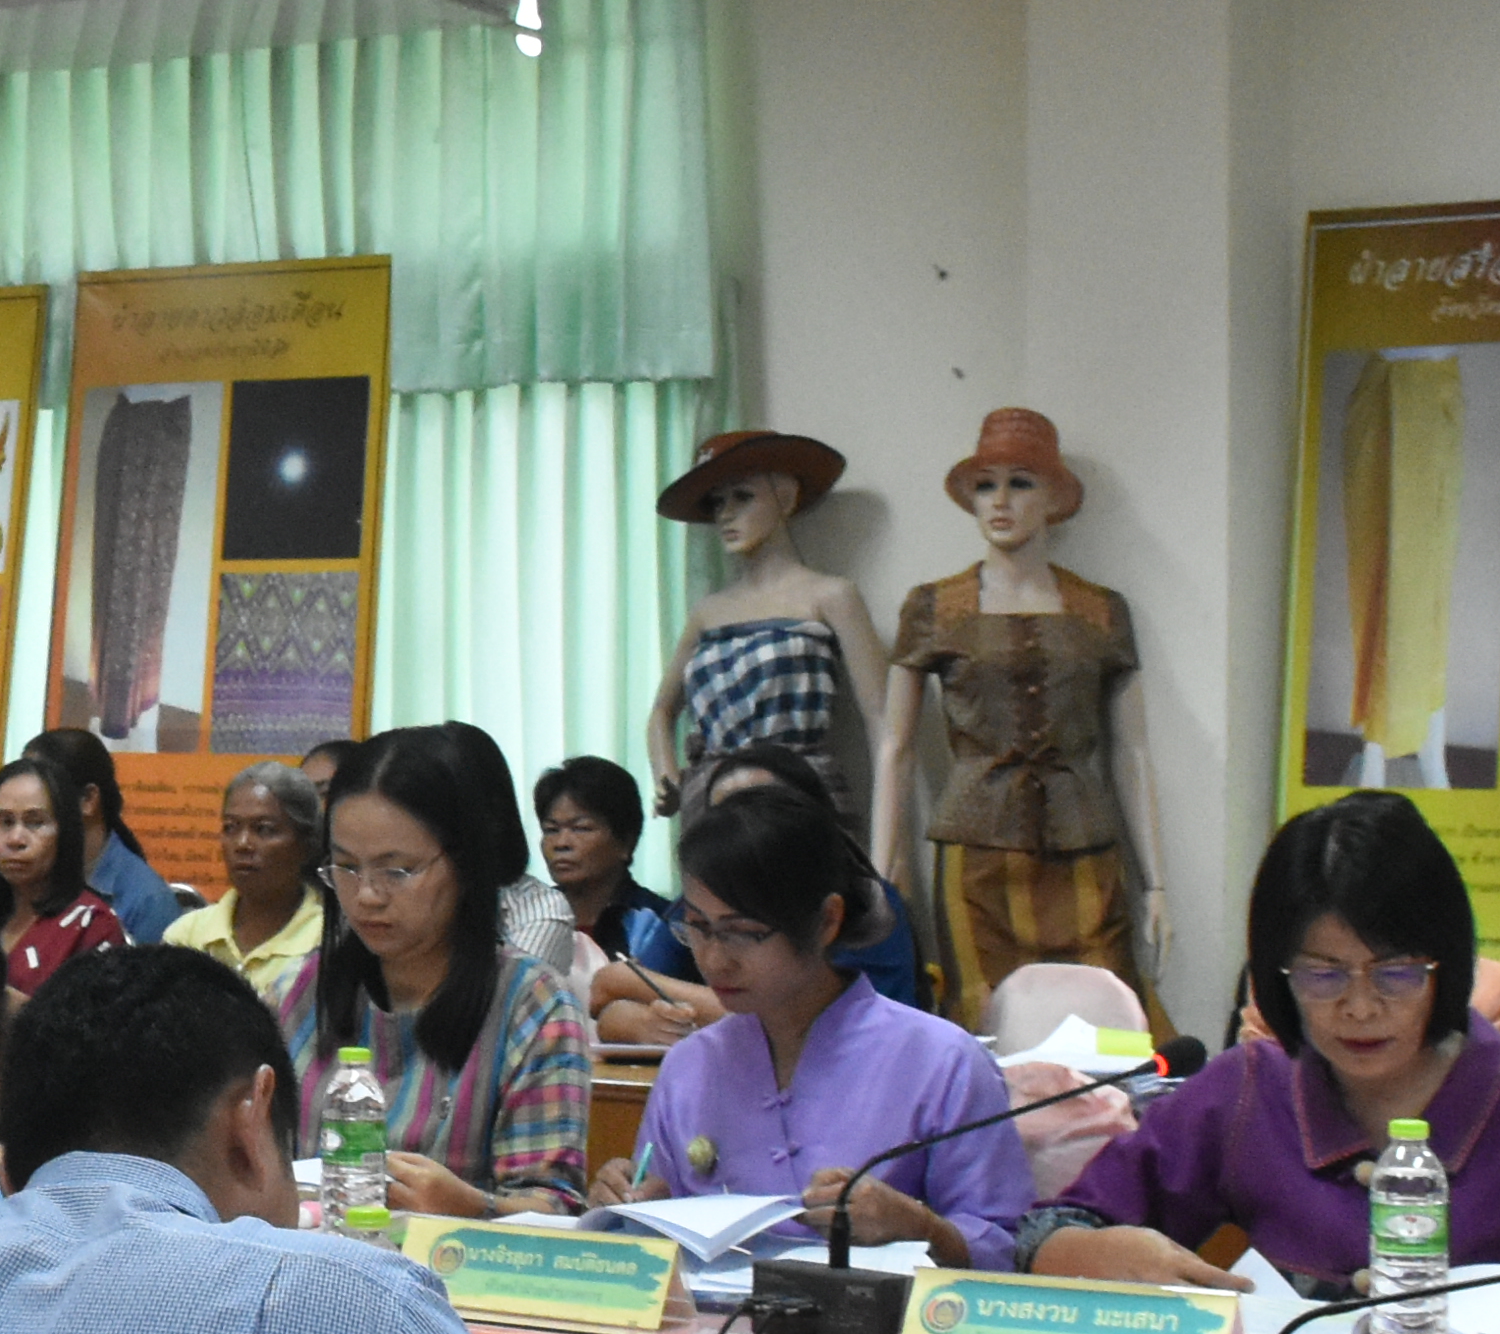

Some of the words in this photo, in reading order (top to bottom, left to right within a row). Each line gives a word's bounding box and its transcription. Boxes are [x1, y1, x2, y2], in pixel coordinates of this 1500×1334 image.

[977, 1298, 1079, 1324] นางสงวน
[1093, 1307, 1179, 1332] มะเสนา
